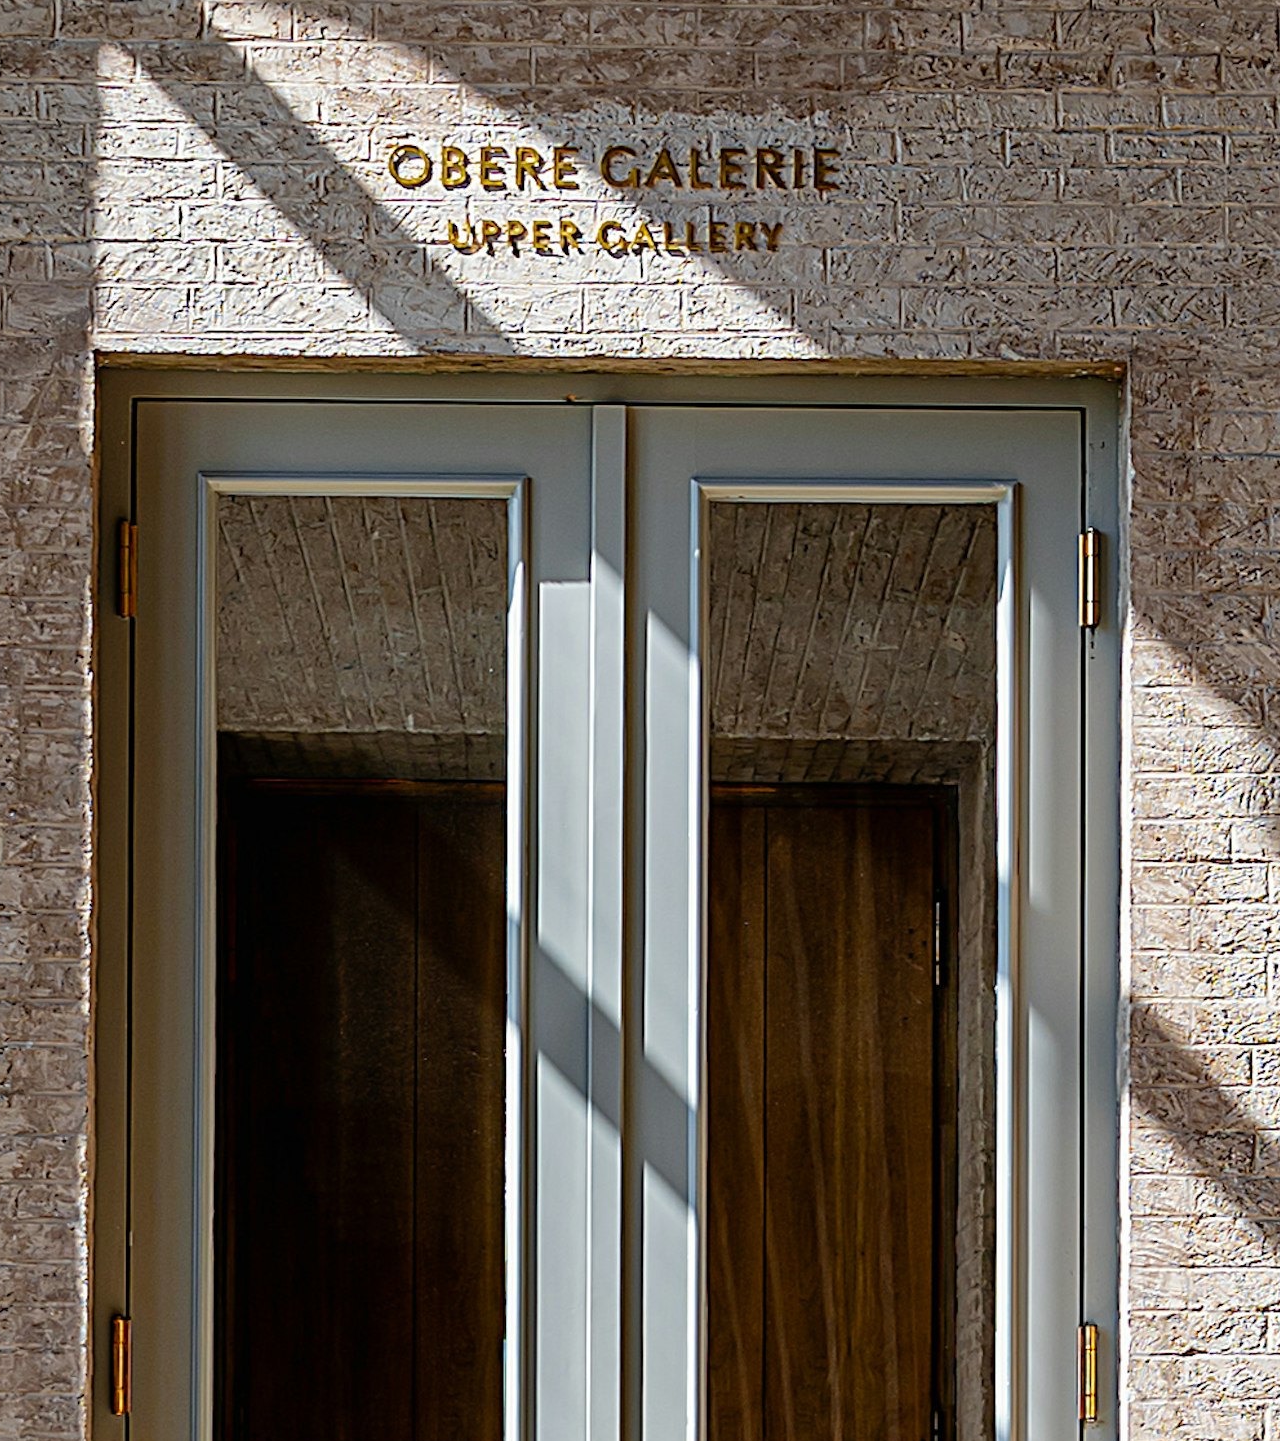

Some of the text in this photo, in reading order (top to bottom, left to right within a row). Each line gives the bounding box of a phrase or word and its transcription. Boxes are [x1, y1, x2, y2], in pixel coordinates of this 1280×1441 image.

[388, 144, 841, 190] OBERE GALERIE
[448, 219, 783, 254] UPPER GALLERY
